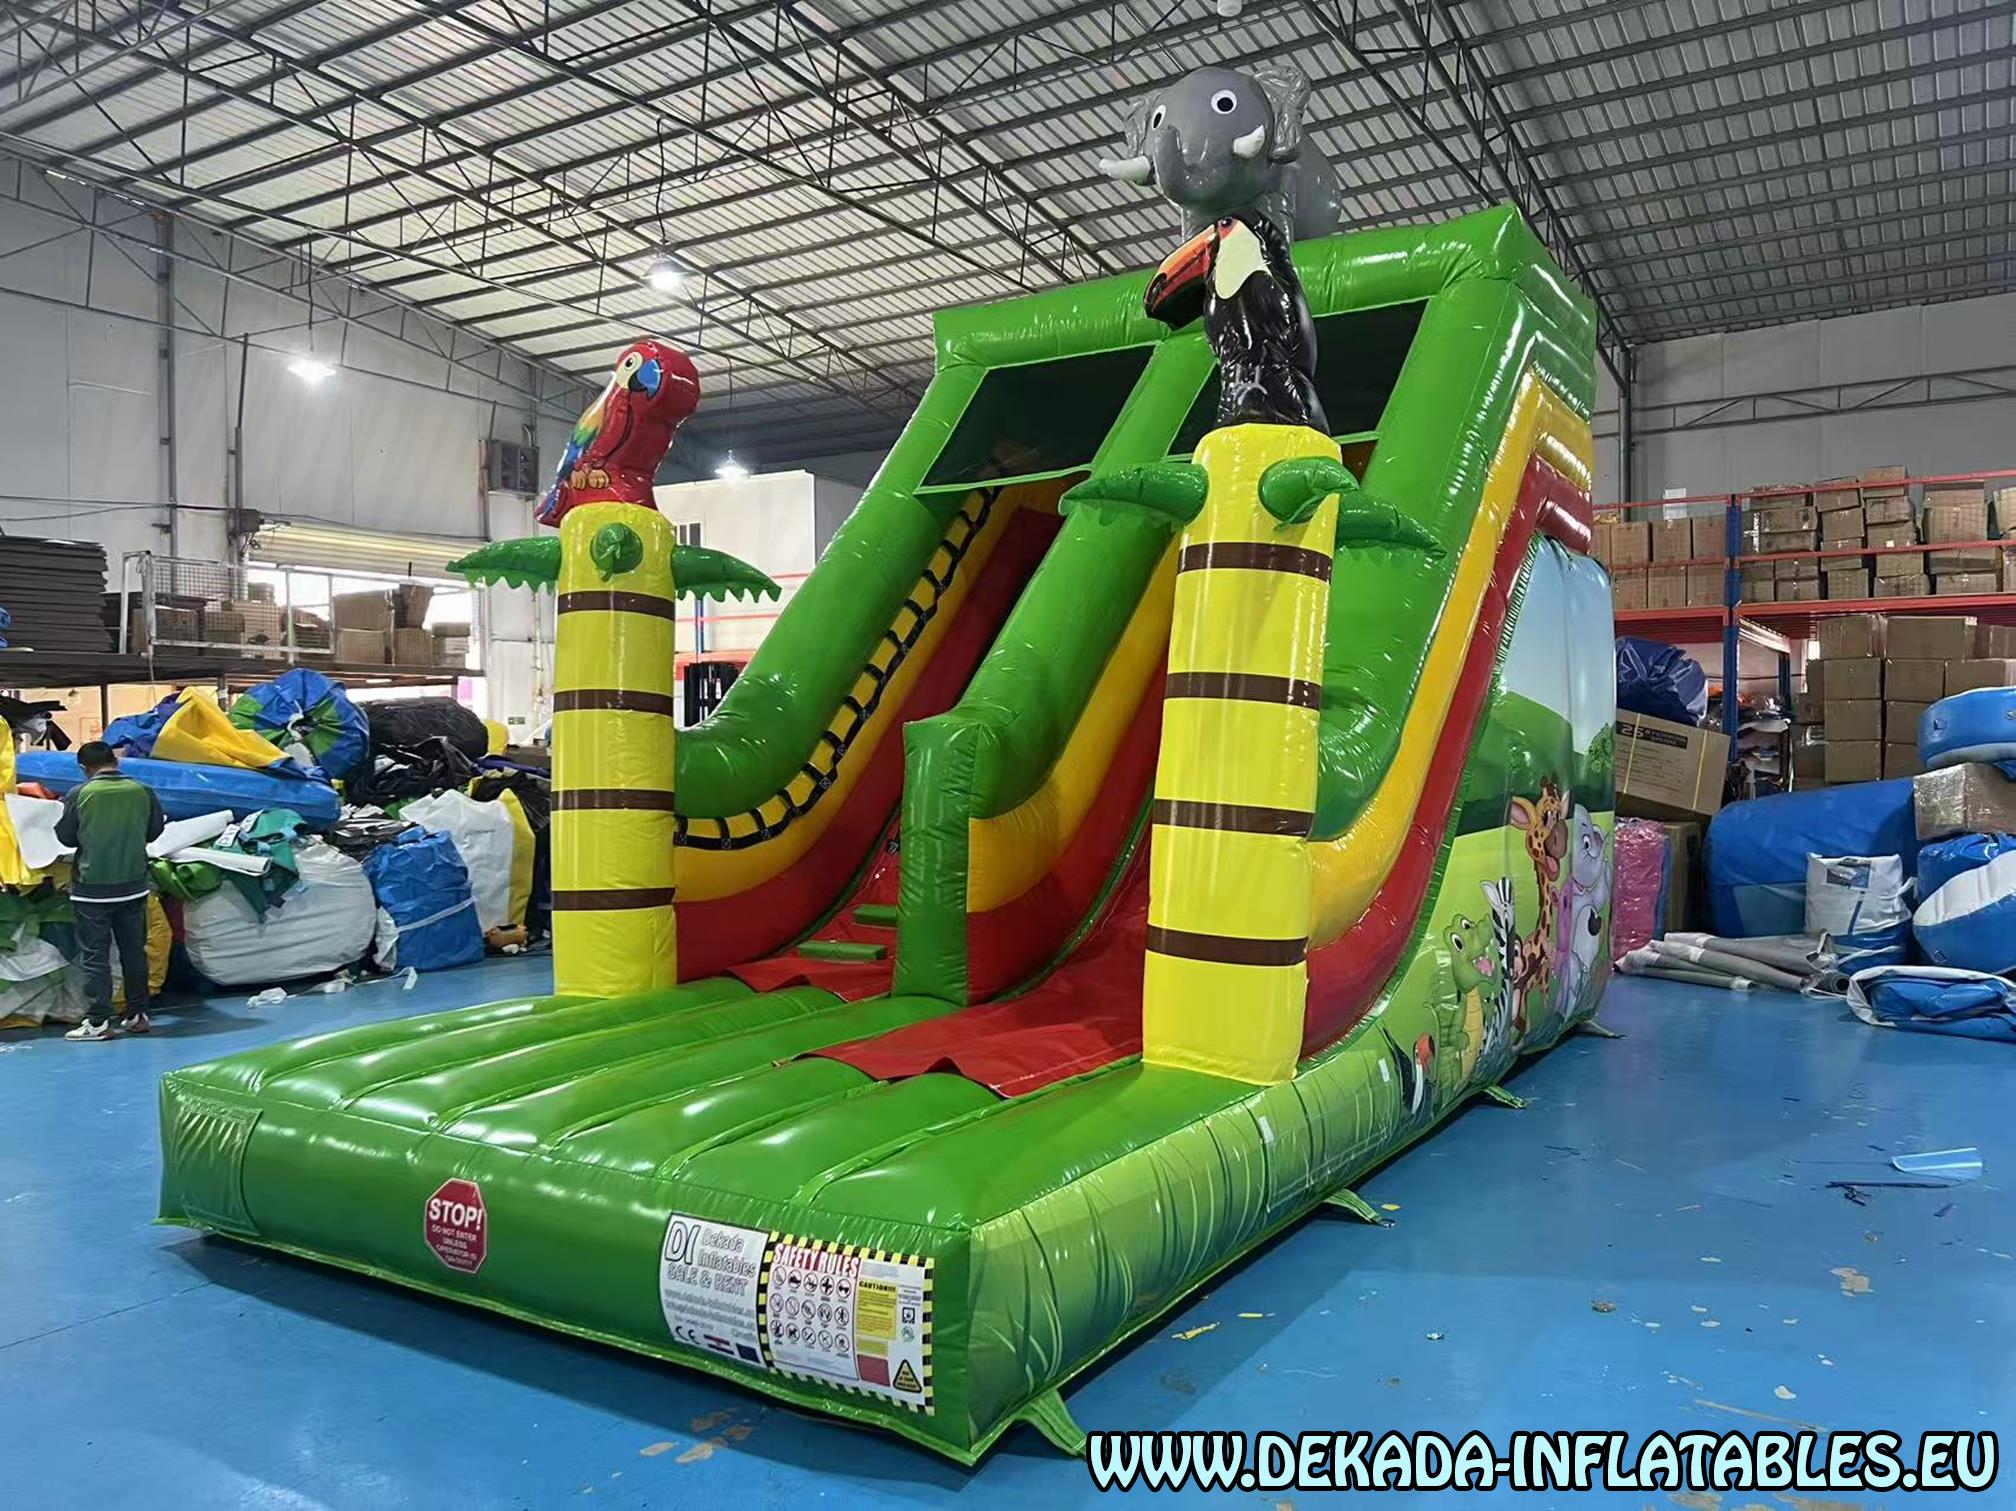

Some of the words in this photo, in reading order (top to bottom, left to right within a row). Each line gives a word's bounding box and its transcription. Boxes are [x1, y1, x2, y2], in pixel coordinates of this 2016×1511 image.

[428, 1198, 483, 1231] STOP!
[702, 1228, 745, 1253] Dekada
[698, 1249, 757, 1278] Inflatables
[773, 1243, 819, 1270] SAFETY
[820, 1250, 859, 1278] RULES
[667, 1262, 698, 1286] SALE
[700, 1270, 712, 1288] &
[714, 1273, 749, 1296] RENT
